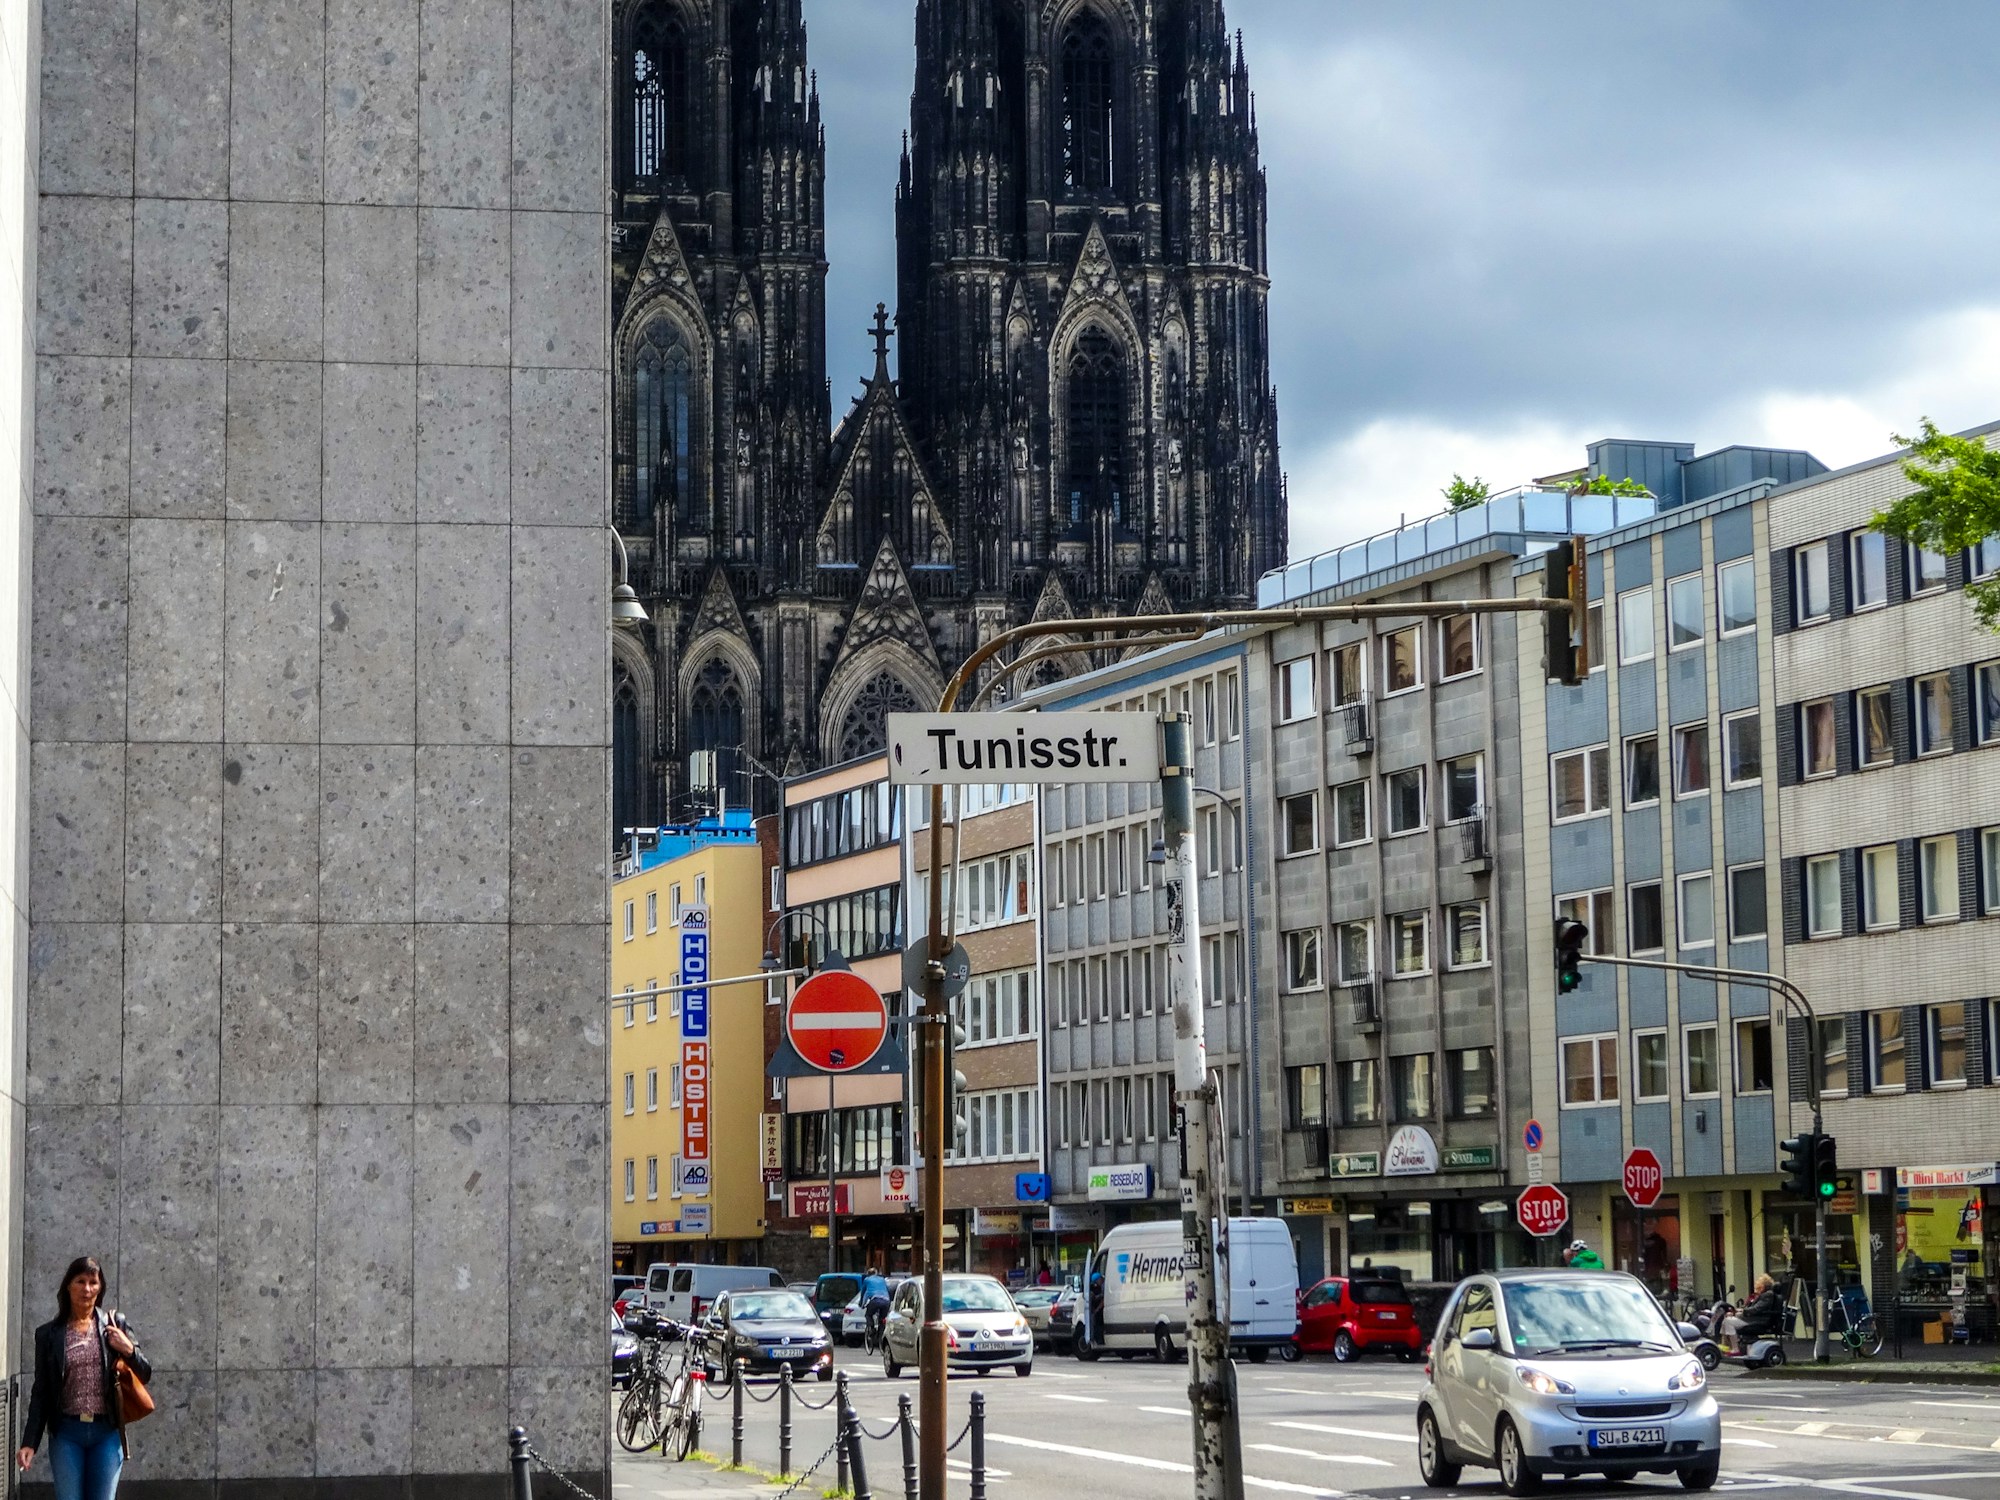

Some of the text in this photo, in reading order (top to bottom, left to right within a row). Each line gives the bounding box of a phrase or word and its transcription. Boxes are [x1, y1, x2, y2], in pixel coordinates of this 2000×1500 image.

[927, 727, 1127, 770] Tunisstr.
[684, 938, 705, 1030] HOTEL
[685, 1045, 705, 1157] HOSTEL
[1627, 1165, 1659, 1189] STOP
[1913, 1172, 1934, 1185] Mini
[1936, 1170, 1964, 1184] Markt
[1522, 1199, 1562, 1221] STOP
[1131, 1252, 1184, 1284] Hermes
[1598, 1429, 1663, 1445] SU B 4211
